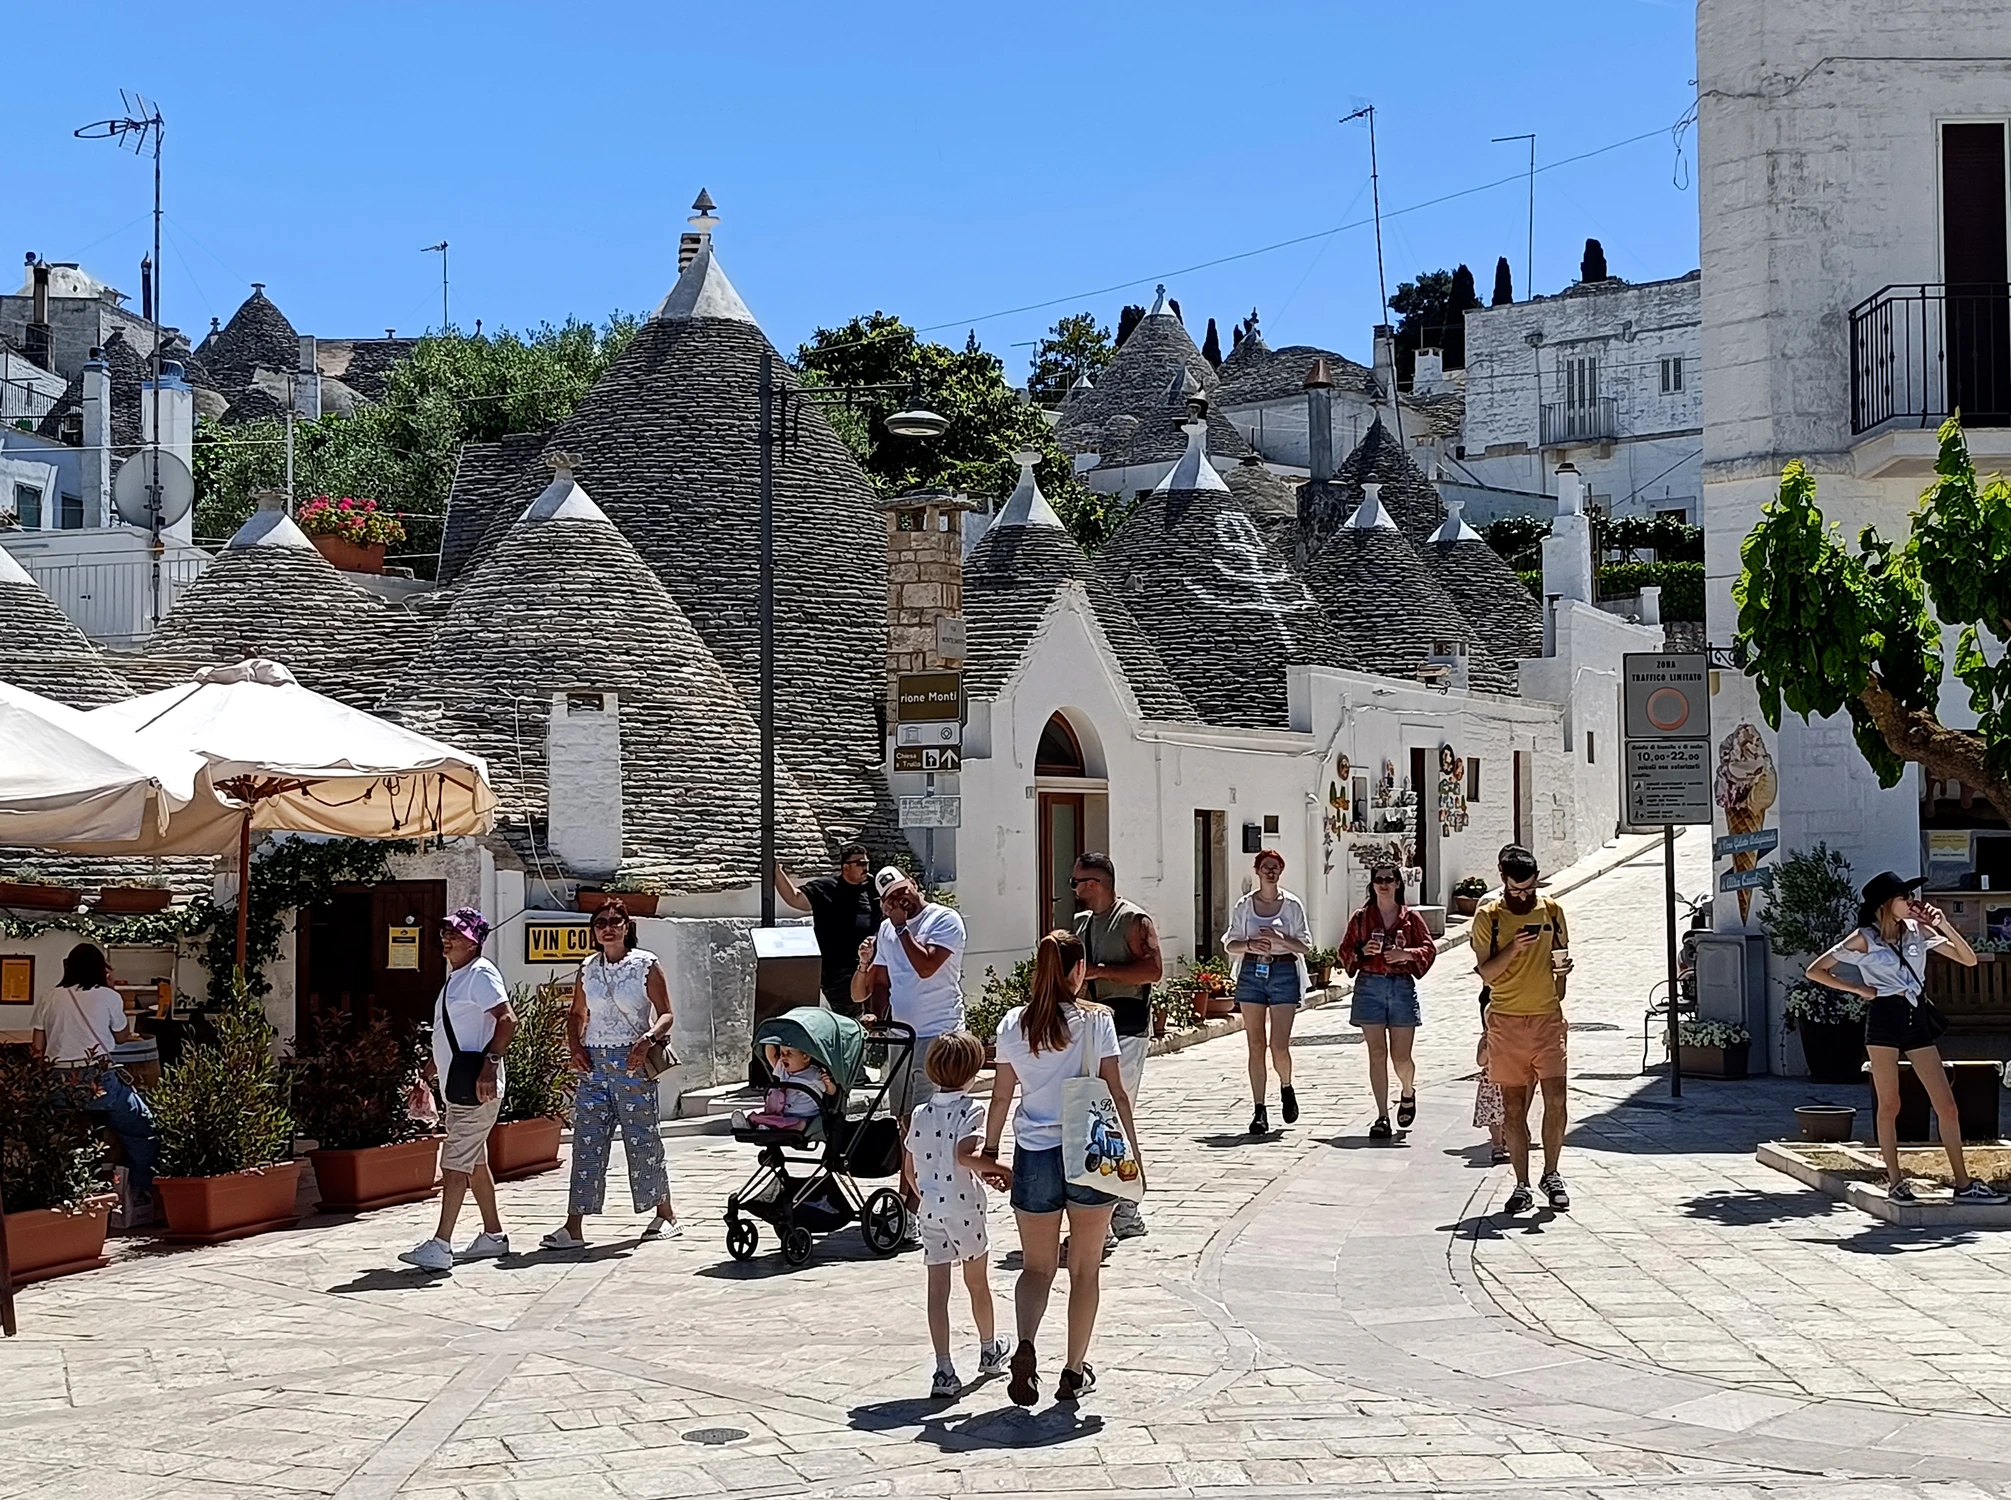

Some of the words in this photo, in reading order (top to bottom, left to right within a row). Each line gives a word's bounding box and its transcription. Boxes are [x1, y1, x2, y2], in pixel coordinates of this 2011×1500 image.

[1656, 661, 1676, 669] ZONA
[1632, 673, 1666, 682] TRAFFICO
[1669, 673, 1702, 682] LIMITATO
[901, 693, 925, 703] rione
[928, 691, 957, 702] Monti
[896, 752, 917, 760] Chiesa
[903, 760, 921, 768] Trullo
[532, 929, 559, 950] VIN
